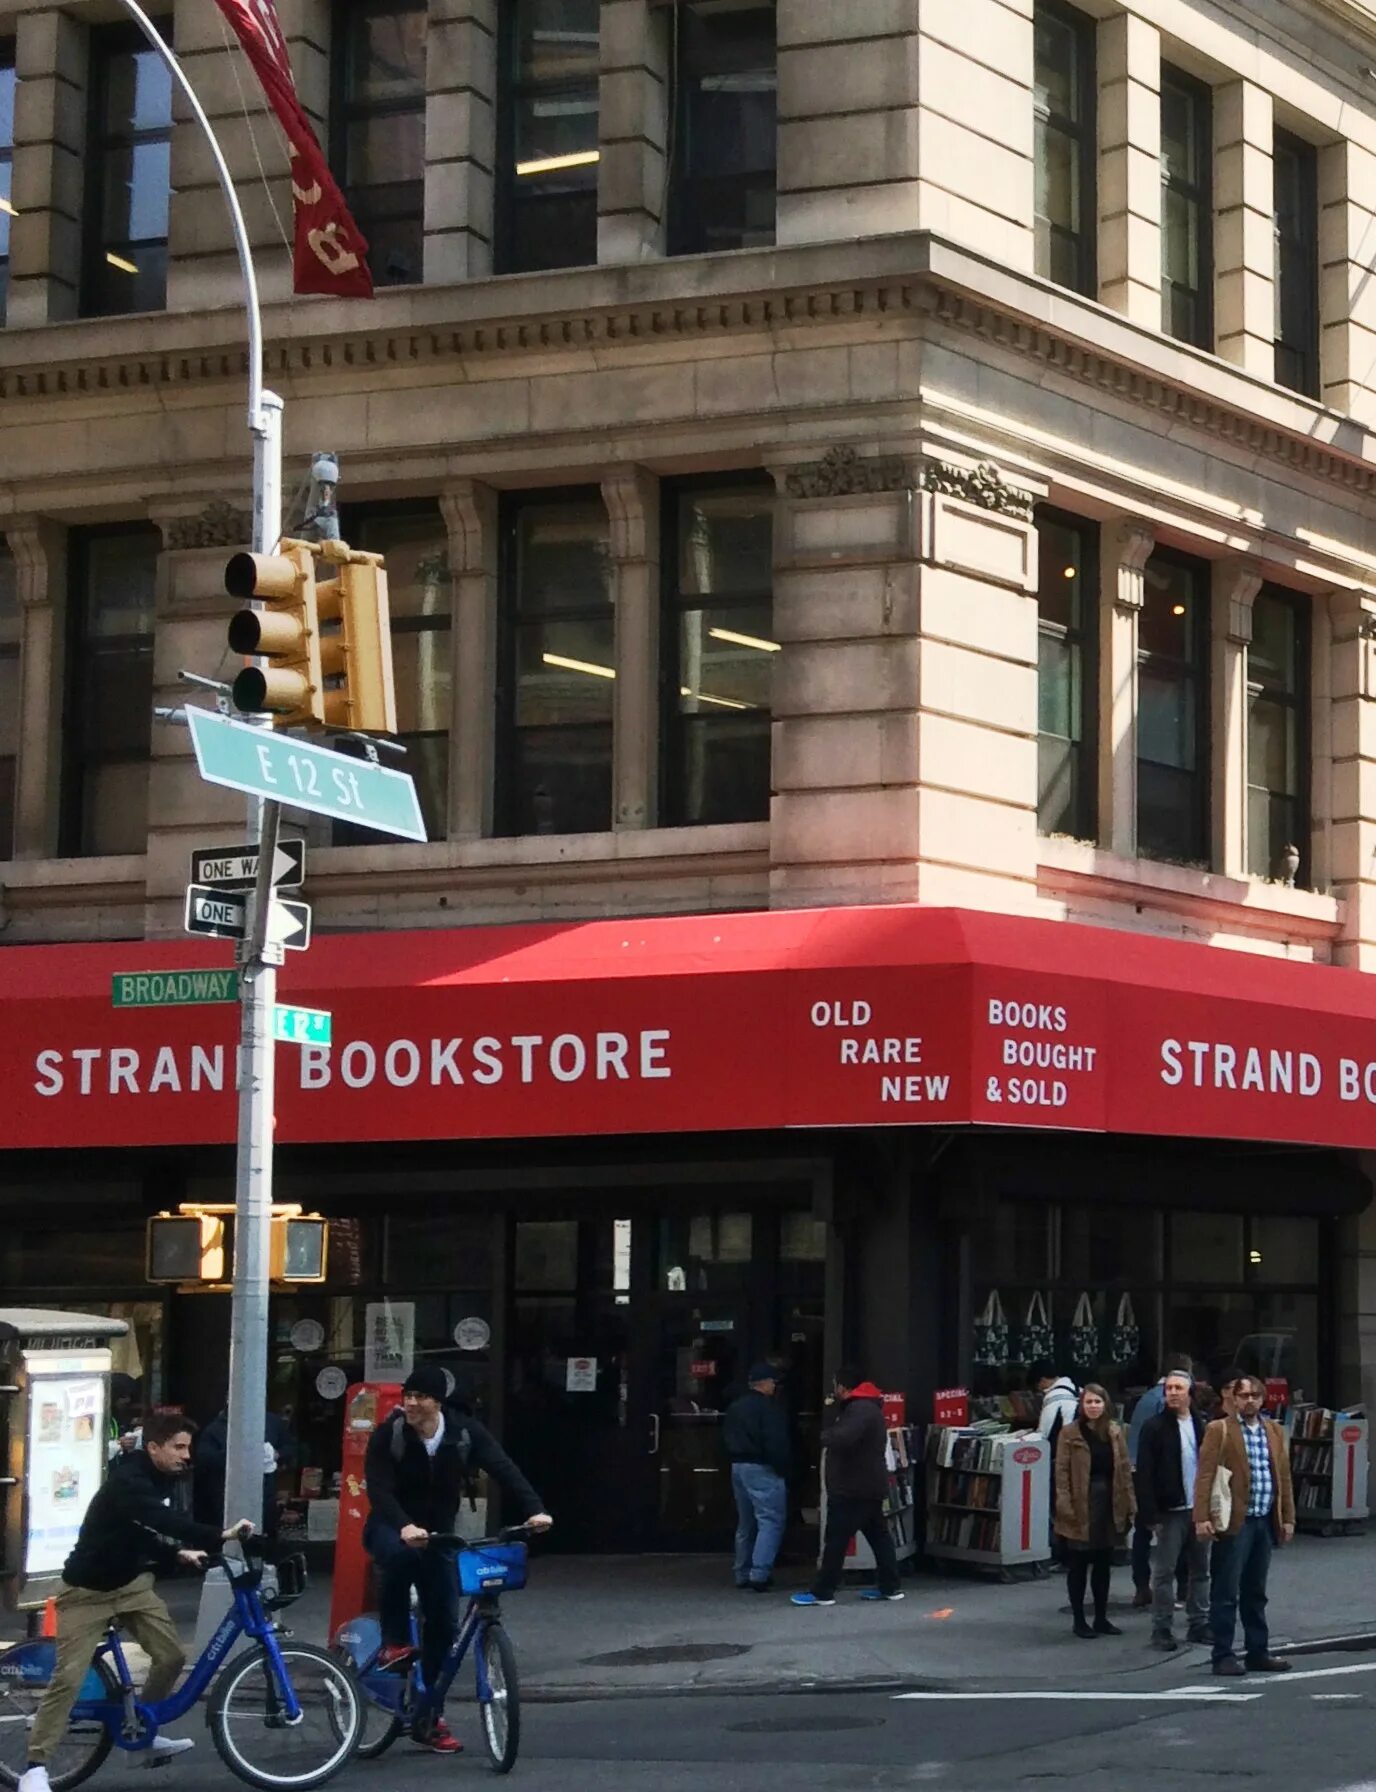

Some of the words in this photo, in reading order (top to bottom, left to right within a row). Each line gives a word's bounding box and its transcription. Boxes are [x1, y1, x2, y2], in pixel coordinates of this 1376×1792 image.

[256, 744, 277, 784] E
[288, 754, 322, 797] 12
[332, 767, 364, 810] St
[203, 859, 233, 880] ONE
[241, 857, 260, 876] WA
[201, 902, 233, 923] ONE
[121, 973, 232, 1003] BROADWAY
[277, 1010, 288, 1036] E
[811, 1001, 871, 1026] OLD
[988, 999, 1067, 1031] BOOKS
[301, 1030, 672, 1090] BOOKSTORE
[840, 1038, 922, 1063] RARE
[1003, 1039, 1096, 1071] BOUGHT
[1160, 1038, 1321, 1096] STRAND
[881, 1075, 950, 1101] NEW
[986, 1076, 1002, 1102] &
[1008, 1078, 1067, 1106] SOLD
